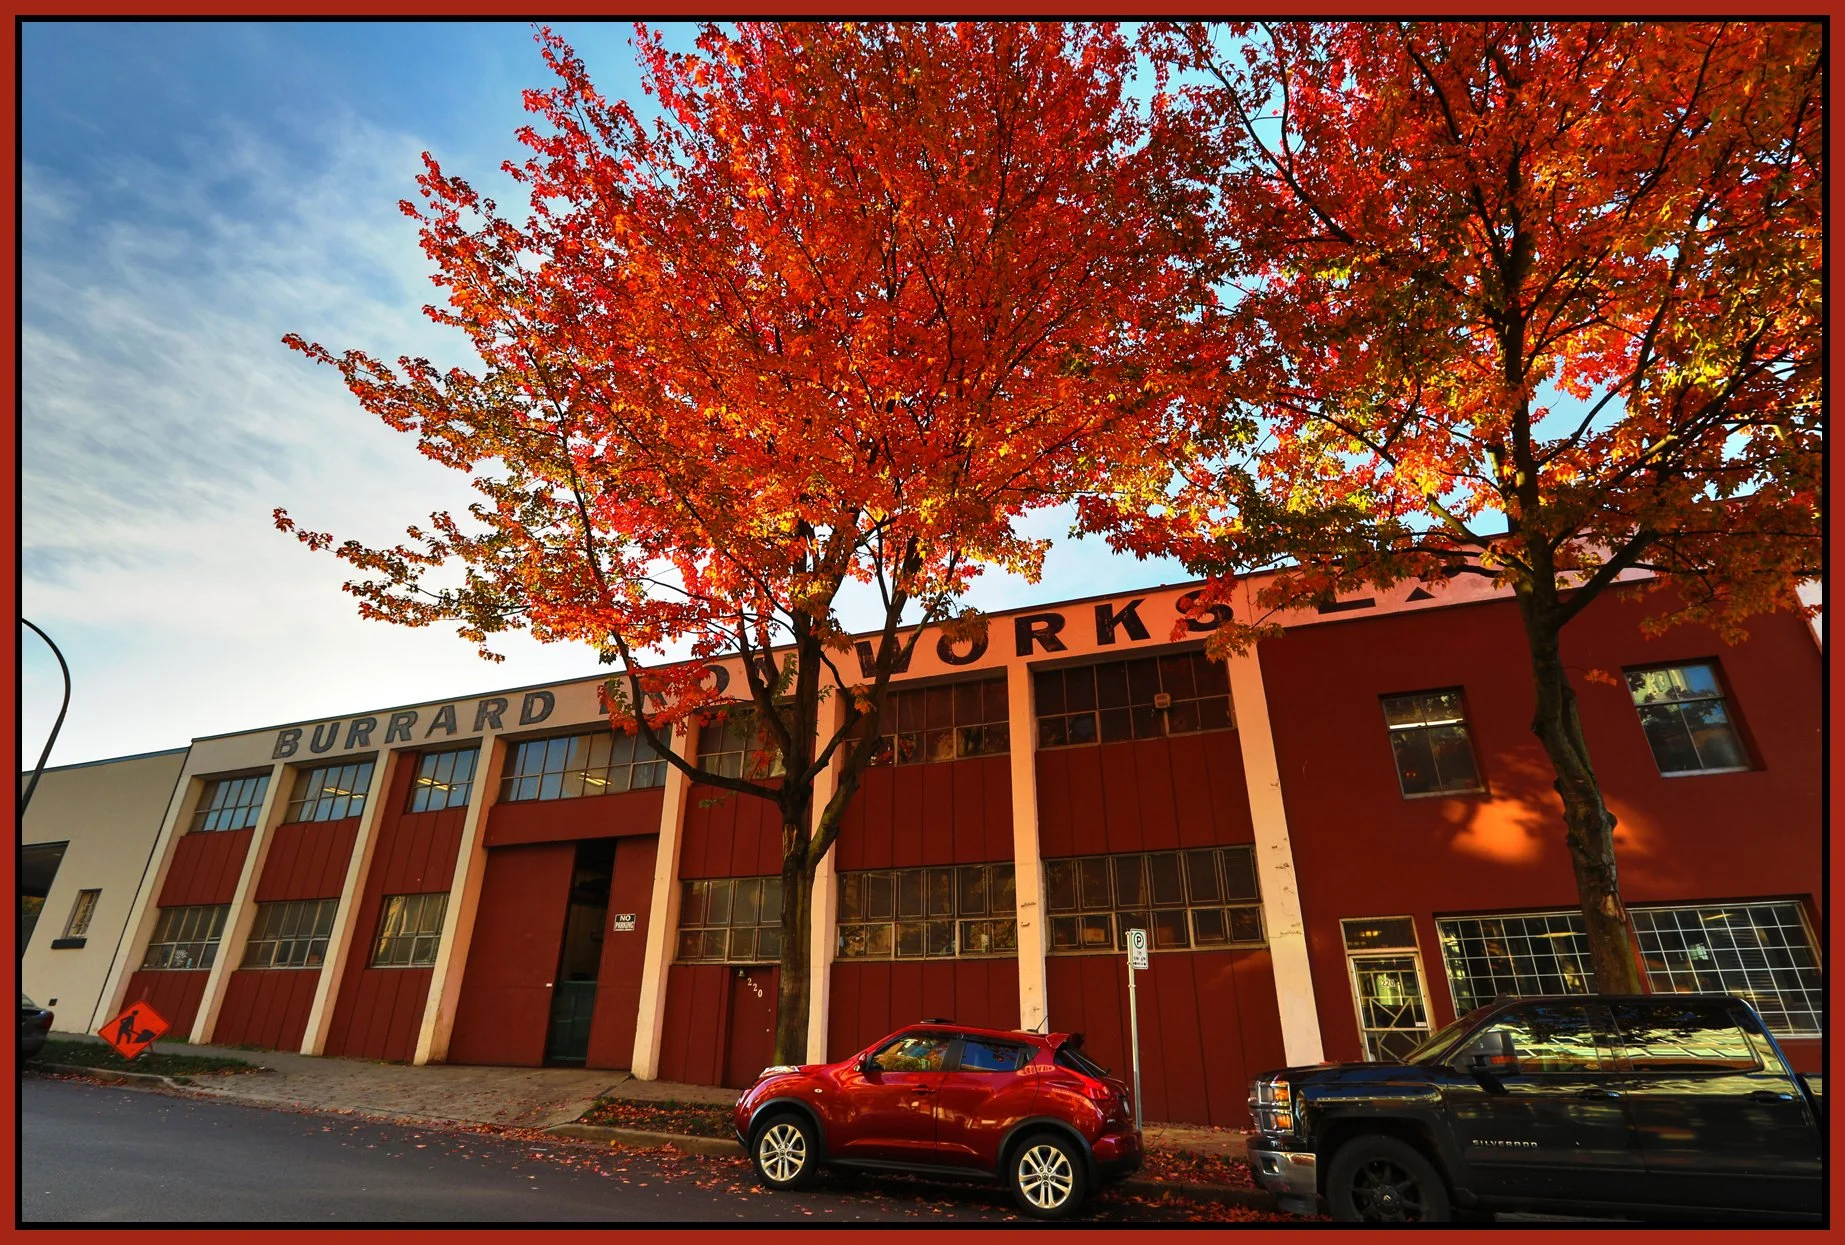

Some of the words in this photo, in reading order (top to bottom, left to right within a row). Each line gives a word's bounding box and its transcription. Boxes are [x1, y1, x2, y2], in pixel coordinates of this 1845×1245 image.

[271, 691, 555, 759] BURRARD
[853, 589, 1235, 678] WORKS
[619, 914, 632, 922] NO
[1136, 935, 1142, 946] P
[747, 977, 763, 998] 220
